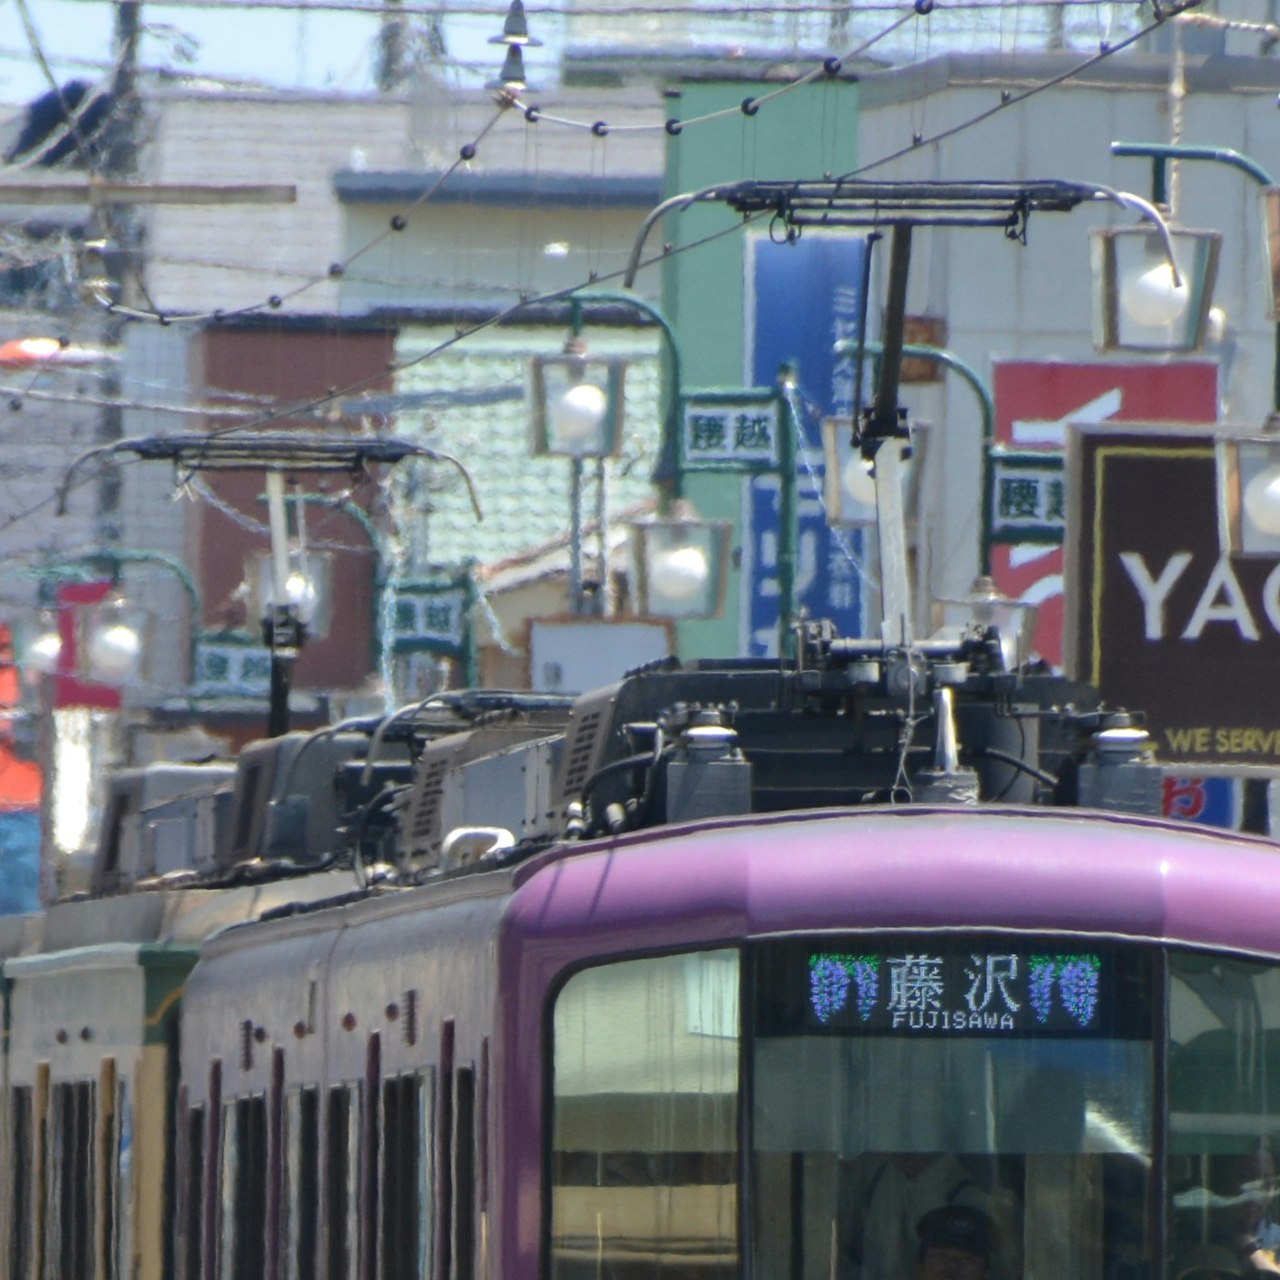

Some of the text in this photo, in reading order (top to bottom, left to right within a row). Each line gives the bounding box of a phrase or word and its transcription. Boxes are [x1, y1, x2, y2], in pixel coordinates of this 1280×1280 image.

[689, 414, 771, 451] 腰越
[1164, 727, 1212, 754] WE
[885, 953, 1021, 1012] 藤沢
[892, 1010, 1015, 1030] FUJISAWA
